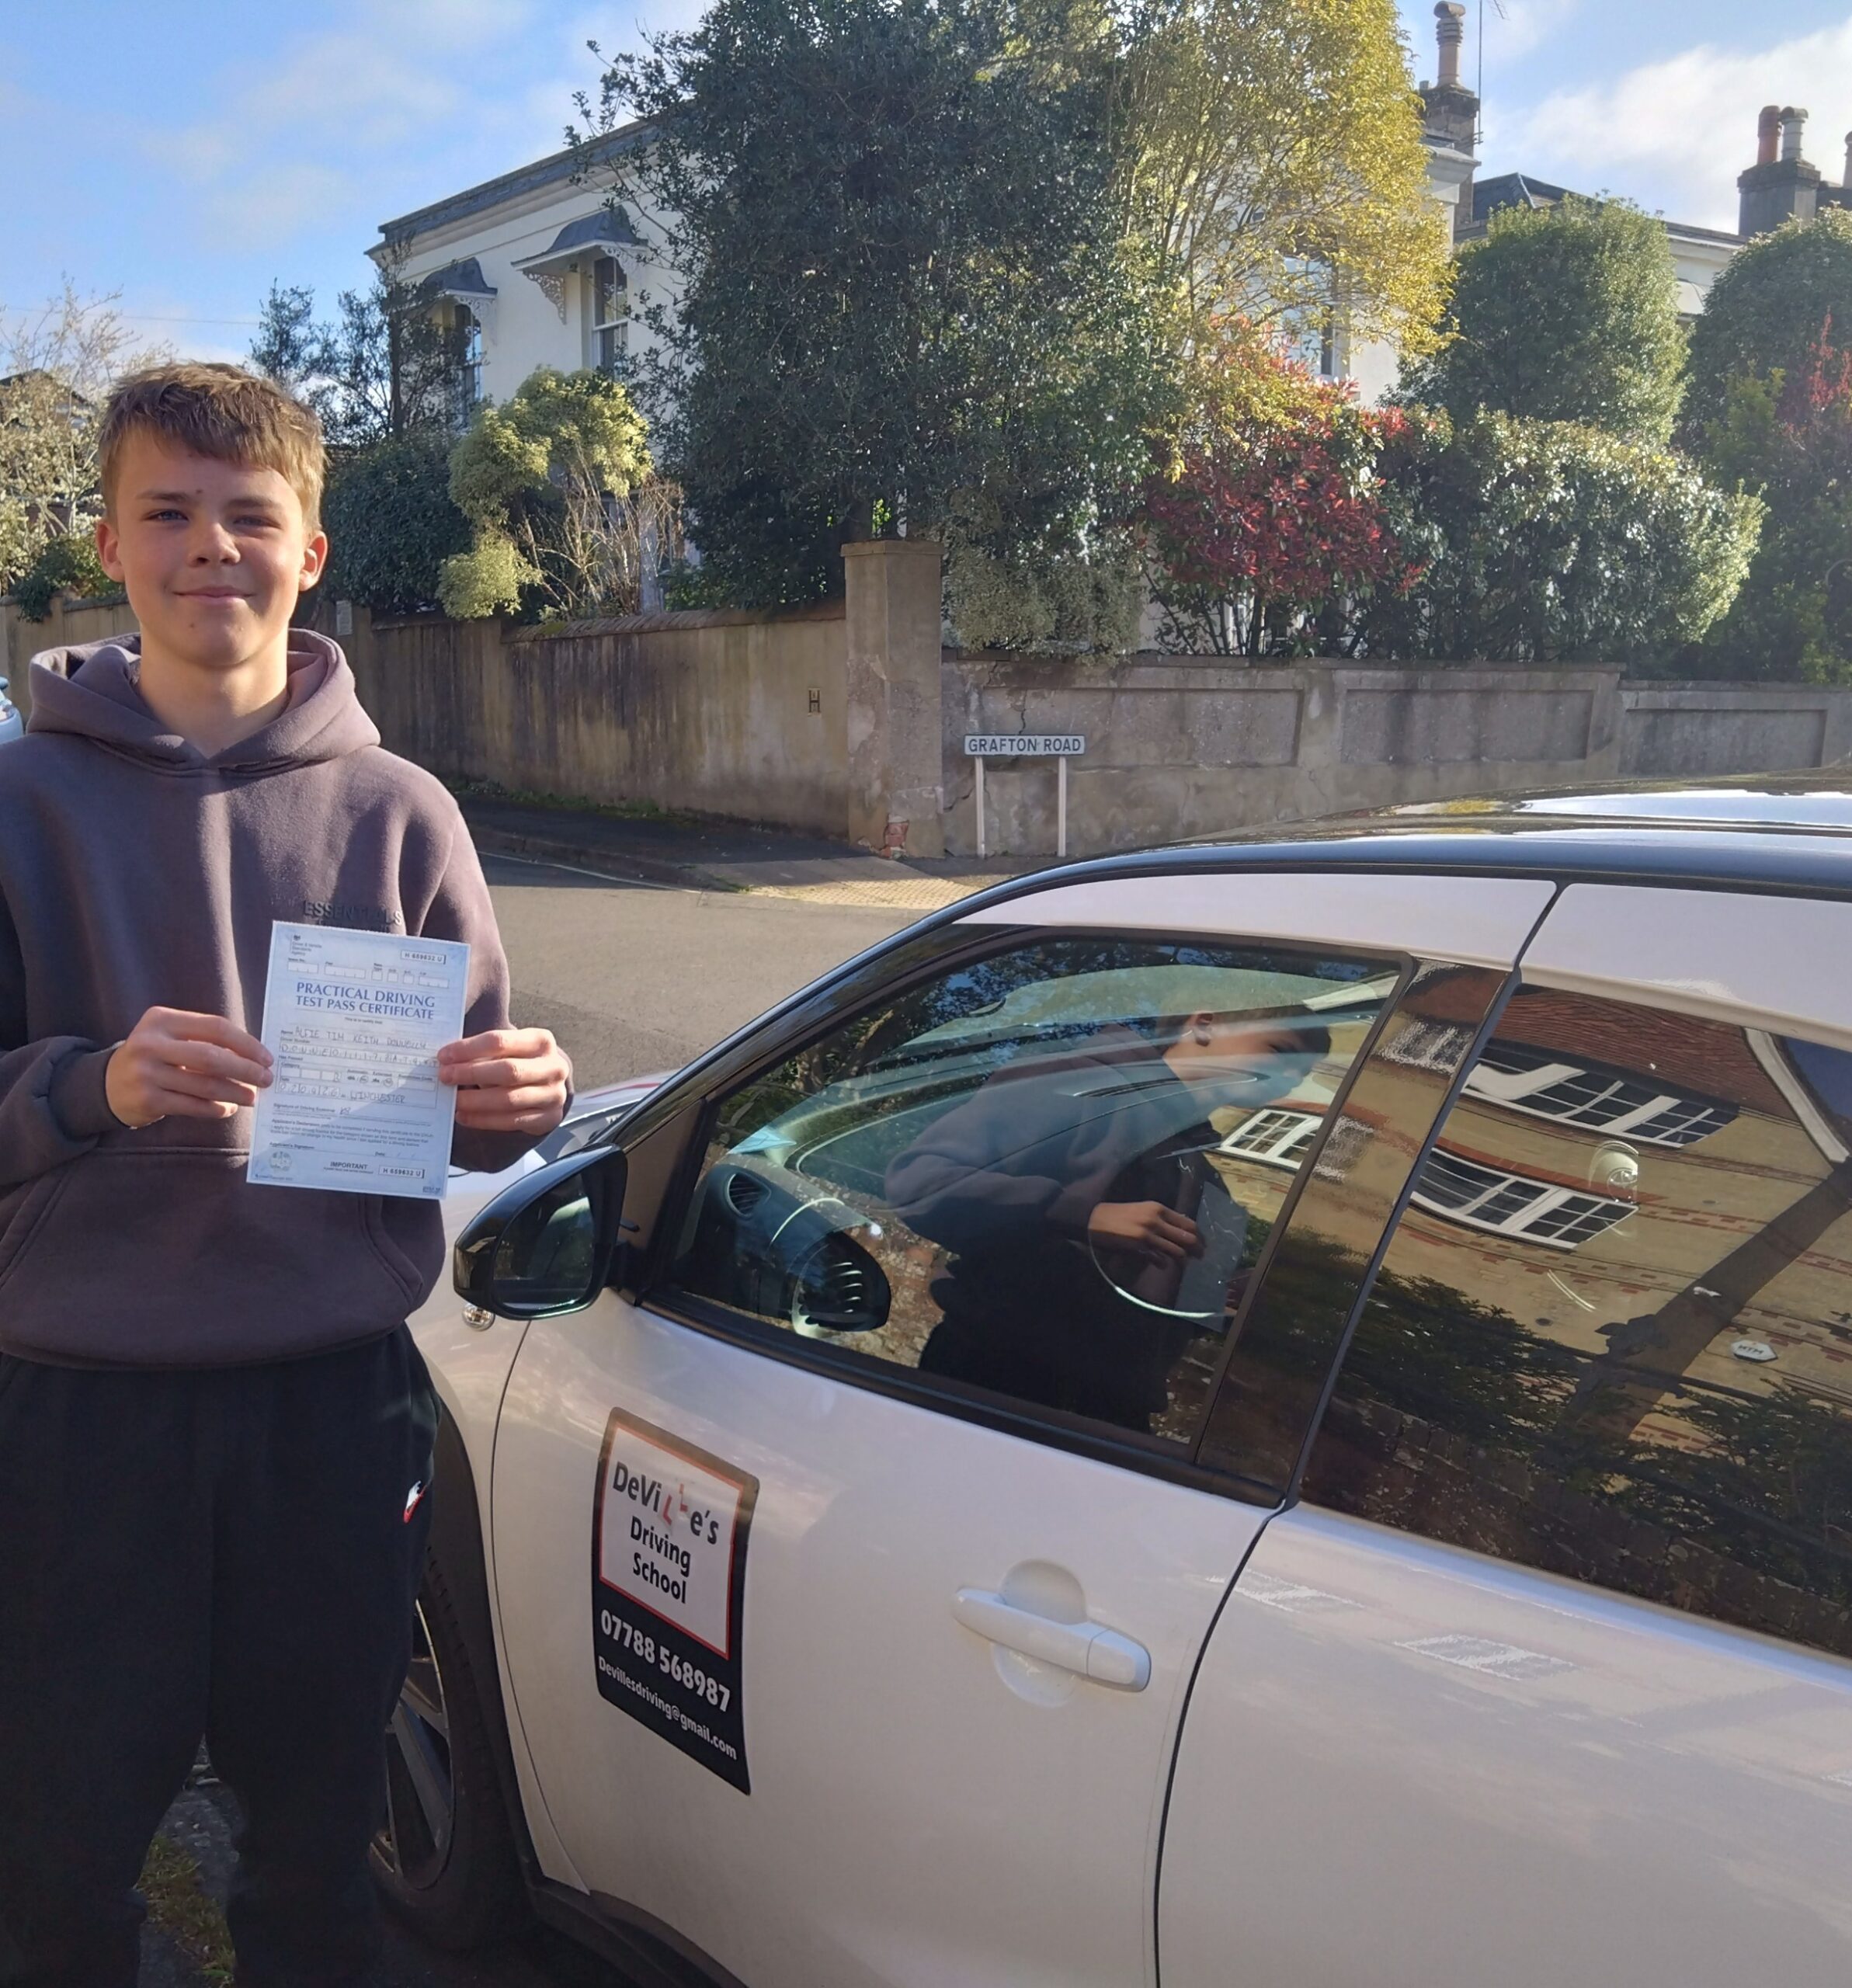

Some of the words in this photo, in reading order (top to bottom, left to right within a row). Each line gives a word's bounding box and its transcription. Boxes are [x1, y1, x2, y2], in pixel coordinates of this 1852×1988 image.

[968, 739, 1037, 752] GRAFTON
[1044, 739, 1082, 752] ROAD
[296, 995, 324, 1008] TEST
[327, 999, 356, 1011] PASS
[359, 1002, 434, 1020] CERTIFICATE
[297, 982, 370, 1001] PRACTICAL
[374, 990, 436, 1008] DRIVING
[326, 1031, 345, 1041] TIM
[353, 1034, 379, 1045] KEITH
[349, 1090, 405, 1103] WINCHESTER
[330, 1161, 368, 1171] IMPORTANT
[630, 1515, 691, 1578] Driving
[633, 1552, 686, 1604] School
[601, 1609, 655, 1664] 07788
[660, 1646, 731, 1712] 568987
[598, 1655, 738, 1760] Devillesdriving@gmail.com
